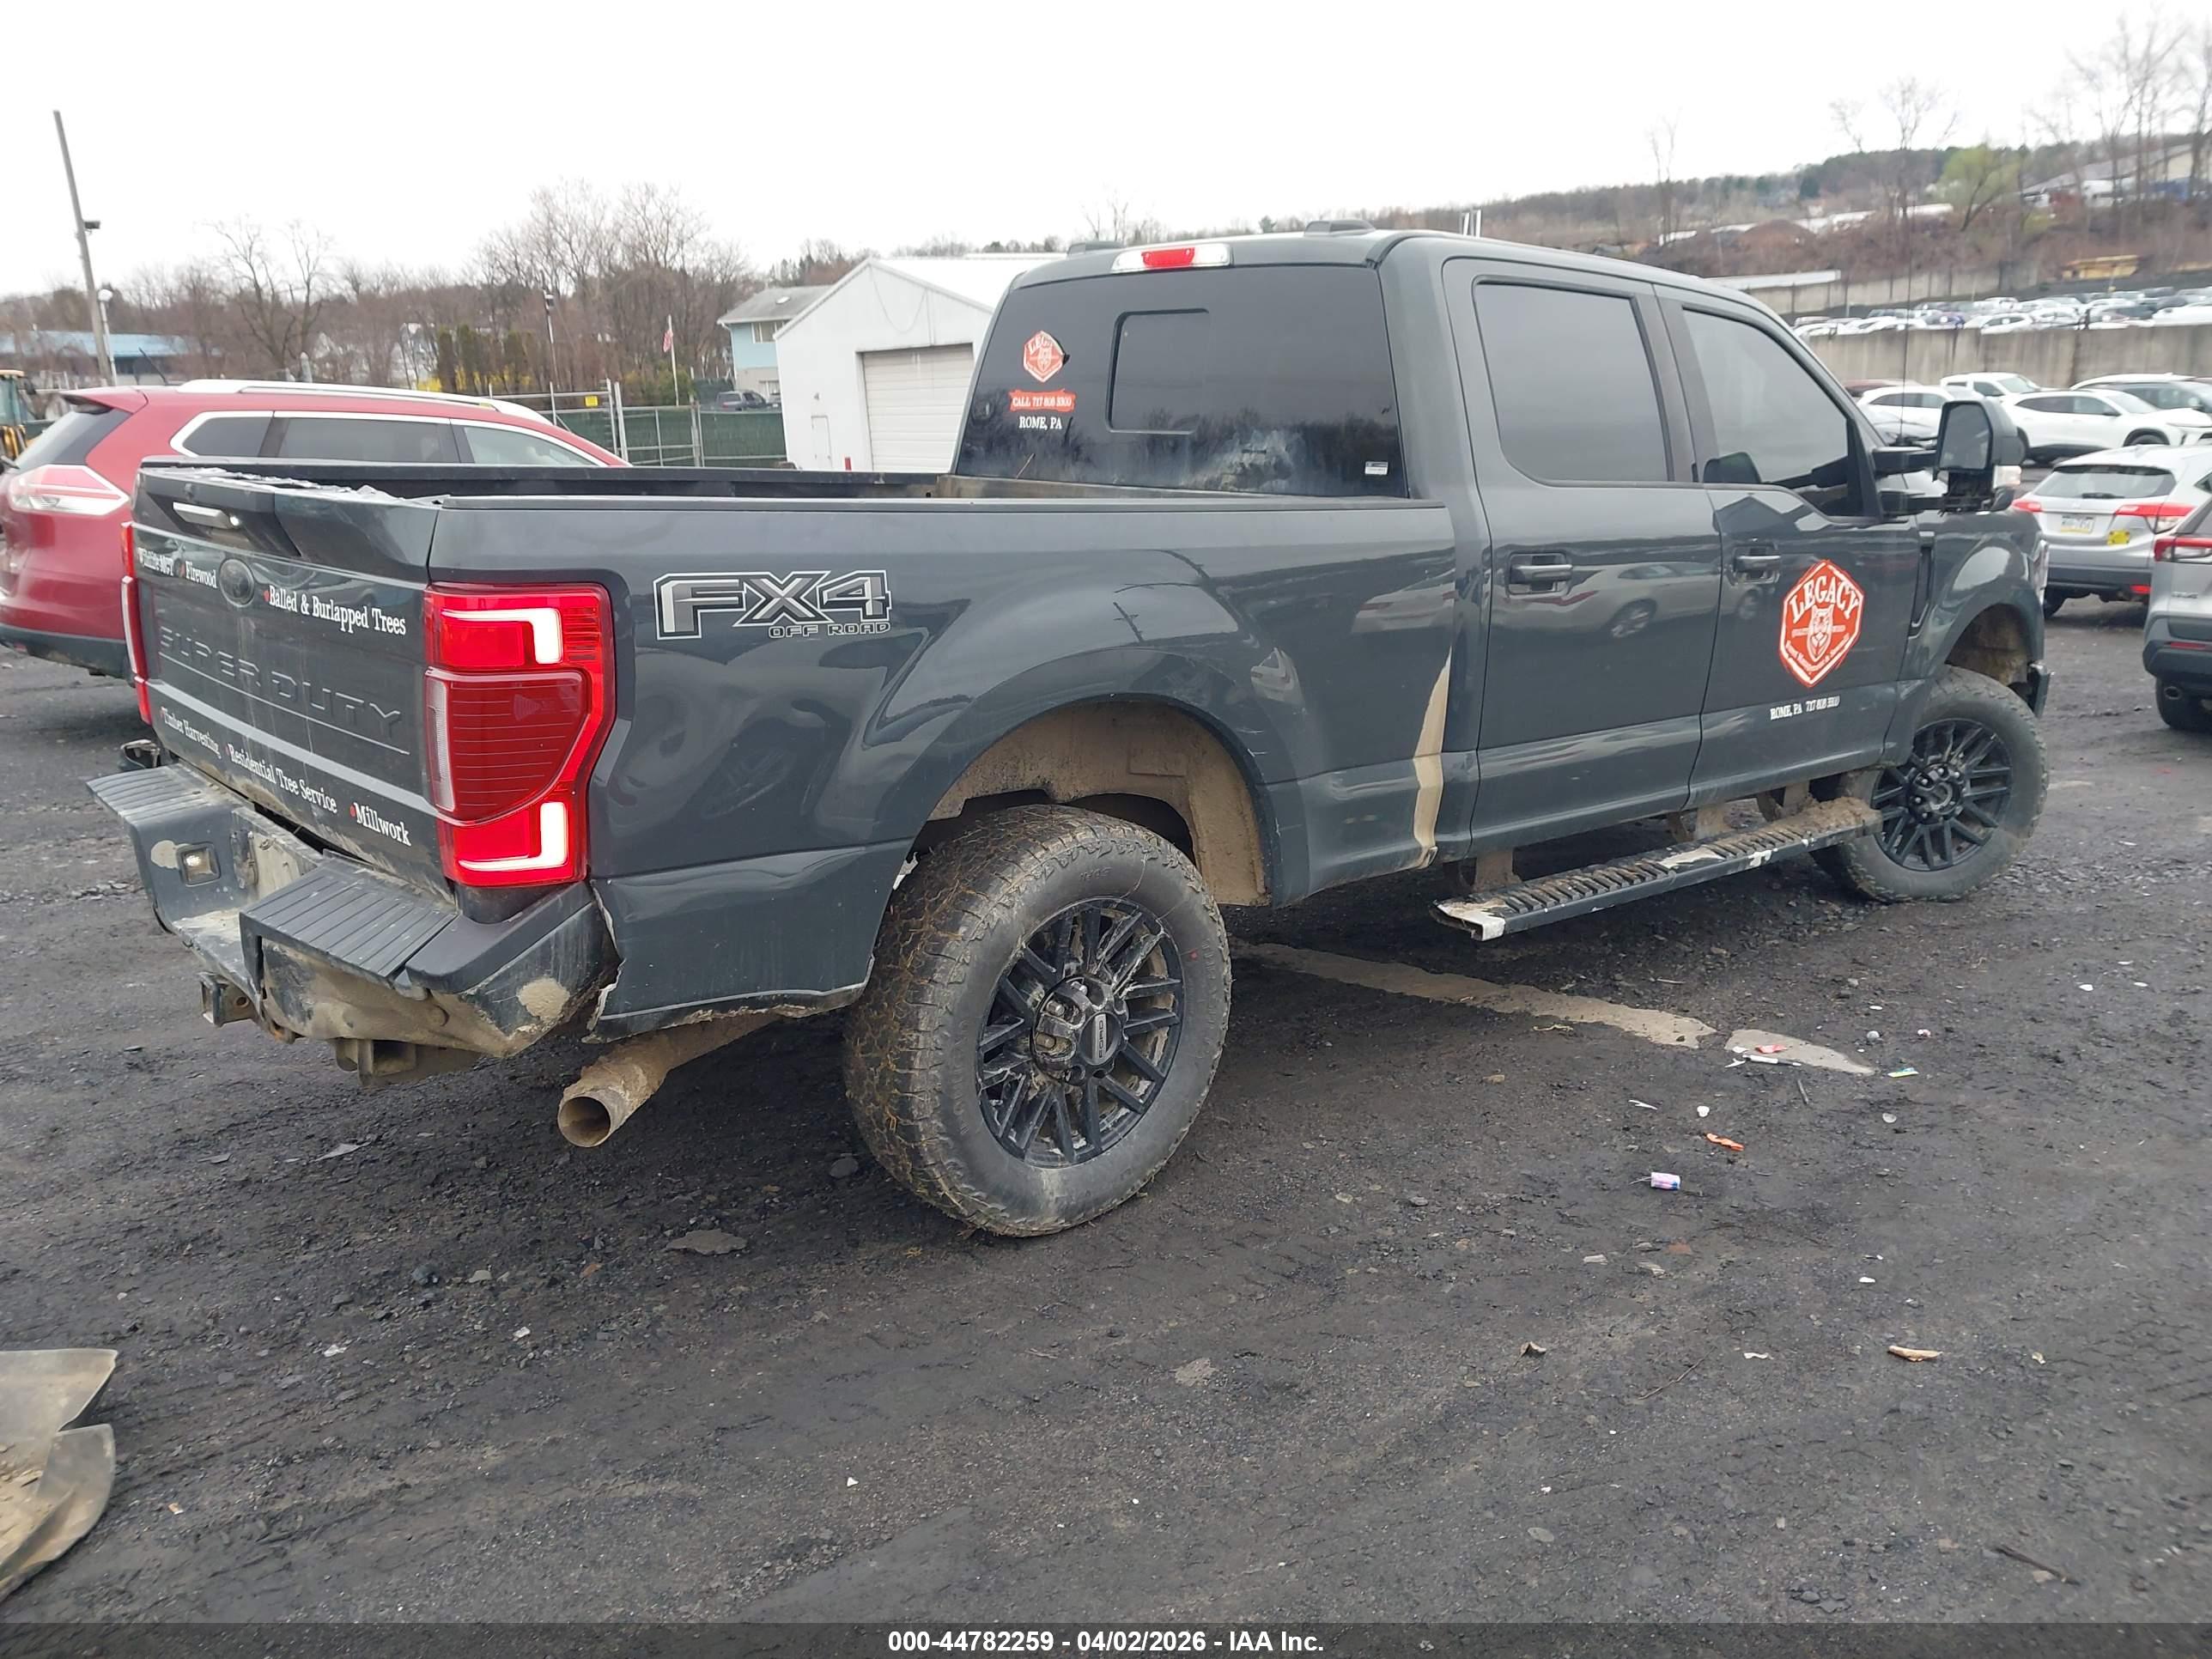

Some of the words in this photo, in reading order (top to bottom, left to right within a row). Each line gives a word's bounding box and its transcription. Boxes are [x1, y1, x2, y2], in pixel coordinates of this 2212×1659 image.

[1012, 396, 1031, 407] CALL
[1018, 416, 1048, 430] ROME,
[1049, 416, 1062, 429] PA
[185, 560, 218, 588] Firewood
[269, 585, 298, 613] Balled
[301, 593, 310, 616] &
[312, 595, 369, 634] Burlapped
[371, 607, 406, 635] Trees
[653, 569, 892, 641] FX4
[1789, 575, 1860, 624] LEGACY
[769, 624, 818, 638] OFF
[827, 622, 891, 635] ROAD
[160, 626, 262, 687] SUPER
[270, 670, 402, 738] DUTY
[1793, 702, 1803, 715] PA
[161, 706, 185, 734] Timber
[182, 719, 222, 759] Harvesting
[227, 743, 276, 784] Residential
[276, 767, 300, 795] Tree
[300, 779, 337, 814] Service
[353, 802, 412, 847] Millwork
